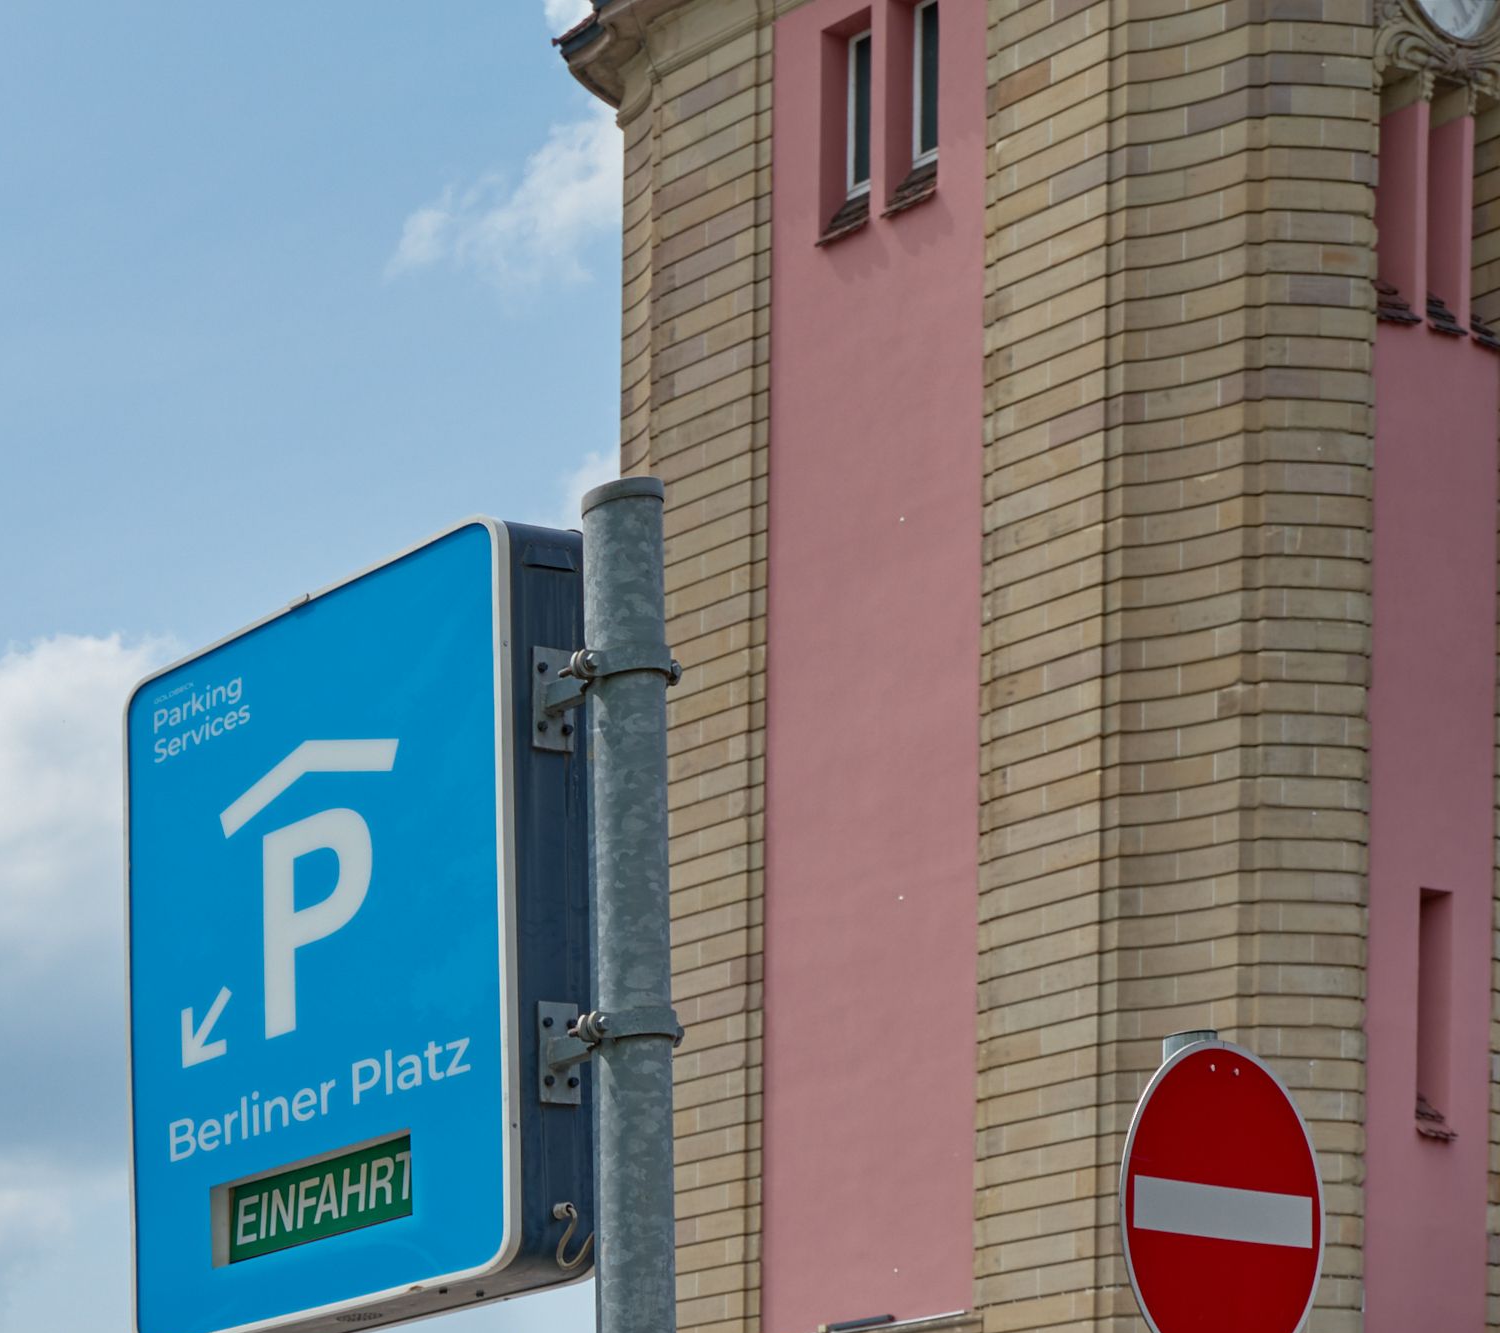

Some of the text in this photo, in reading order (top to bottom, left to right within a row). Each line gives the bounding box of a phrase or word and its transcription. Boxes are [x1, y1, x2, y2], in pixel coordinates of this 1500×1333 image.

[154, 676, 242, 734] Parking
[154, 704, 251, 763] Services
[262, 807, 372, 1040] P
[169, 1037, 471, 1163] Berliner Platz
[236, 1150, 412, 1246] EINFAHRT
